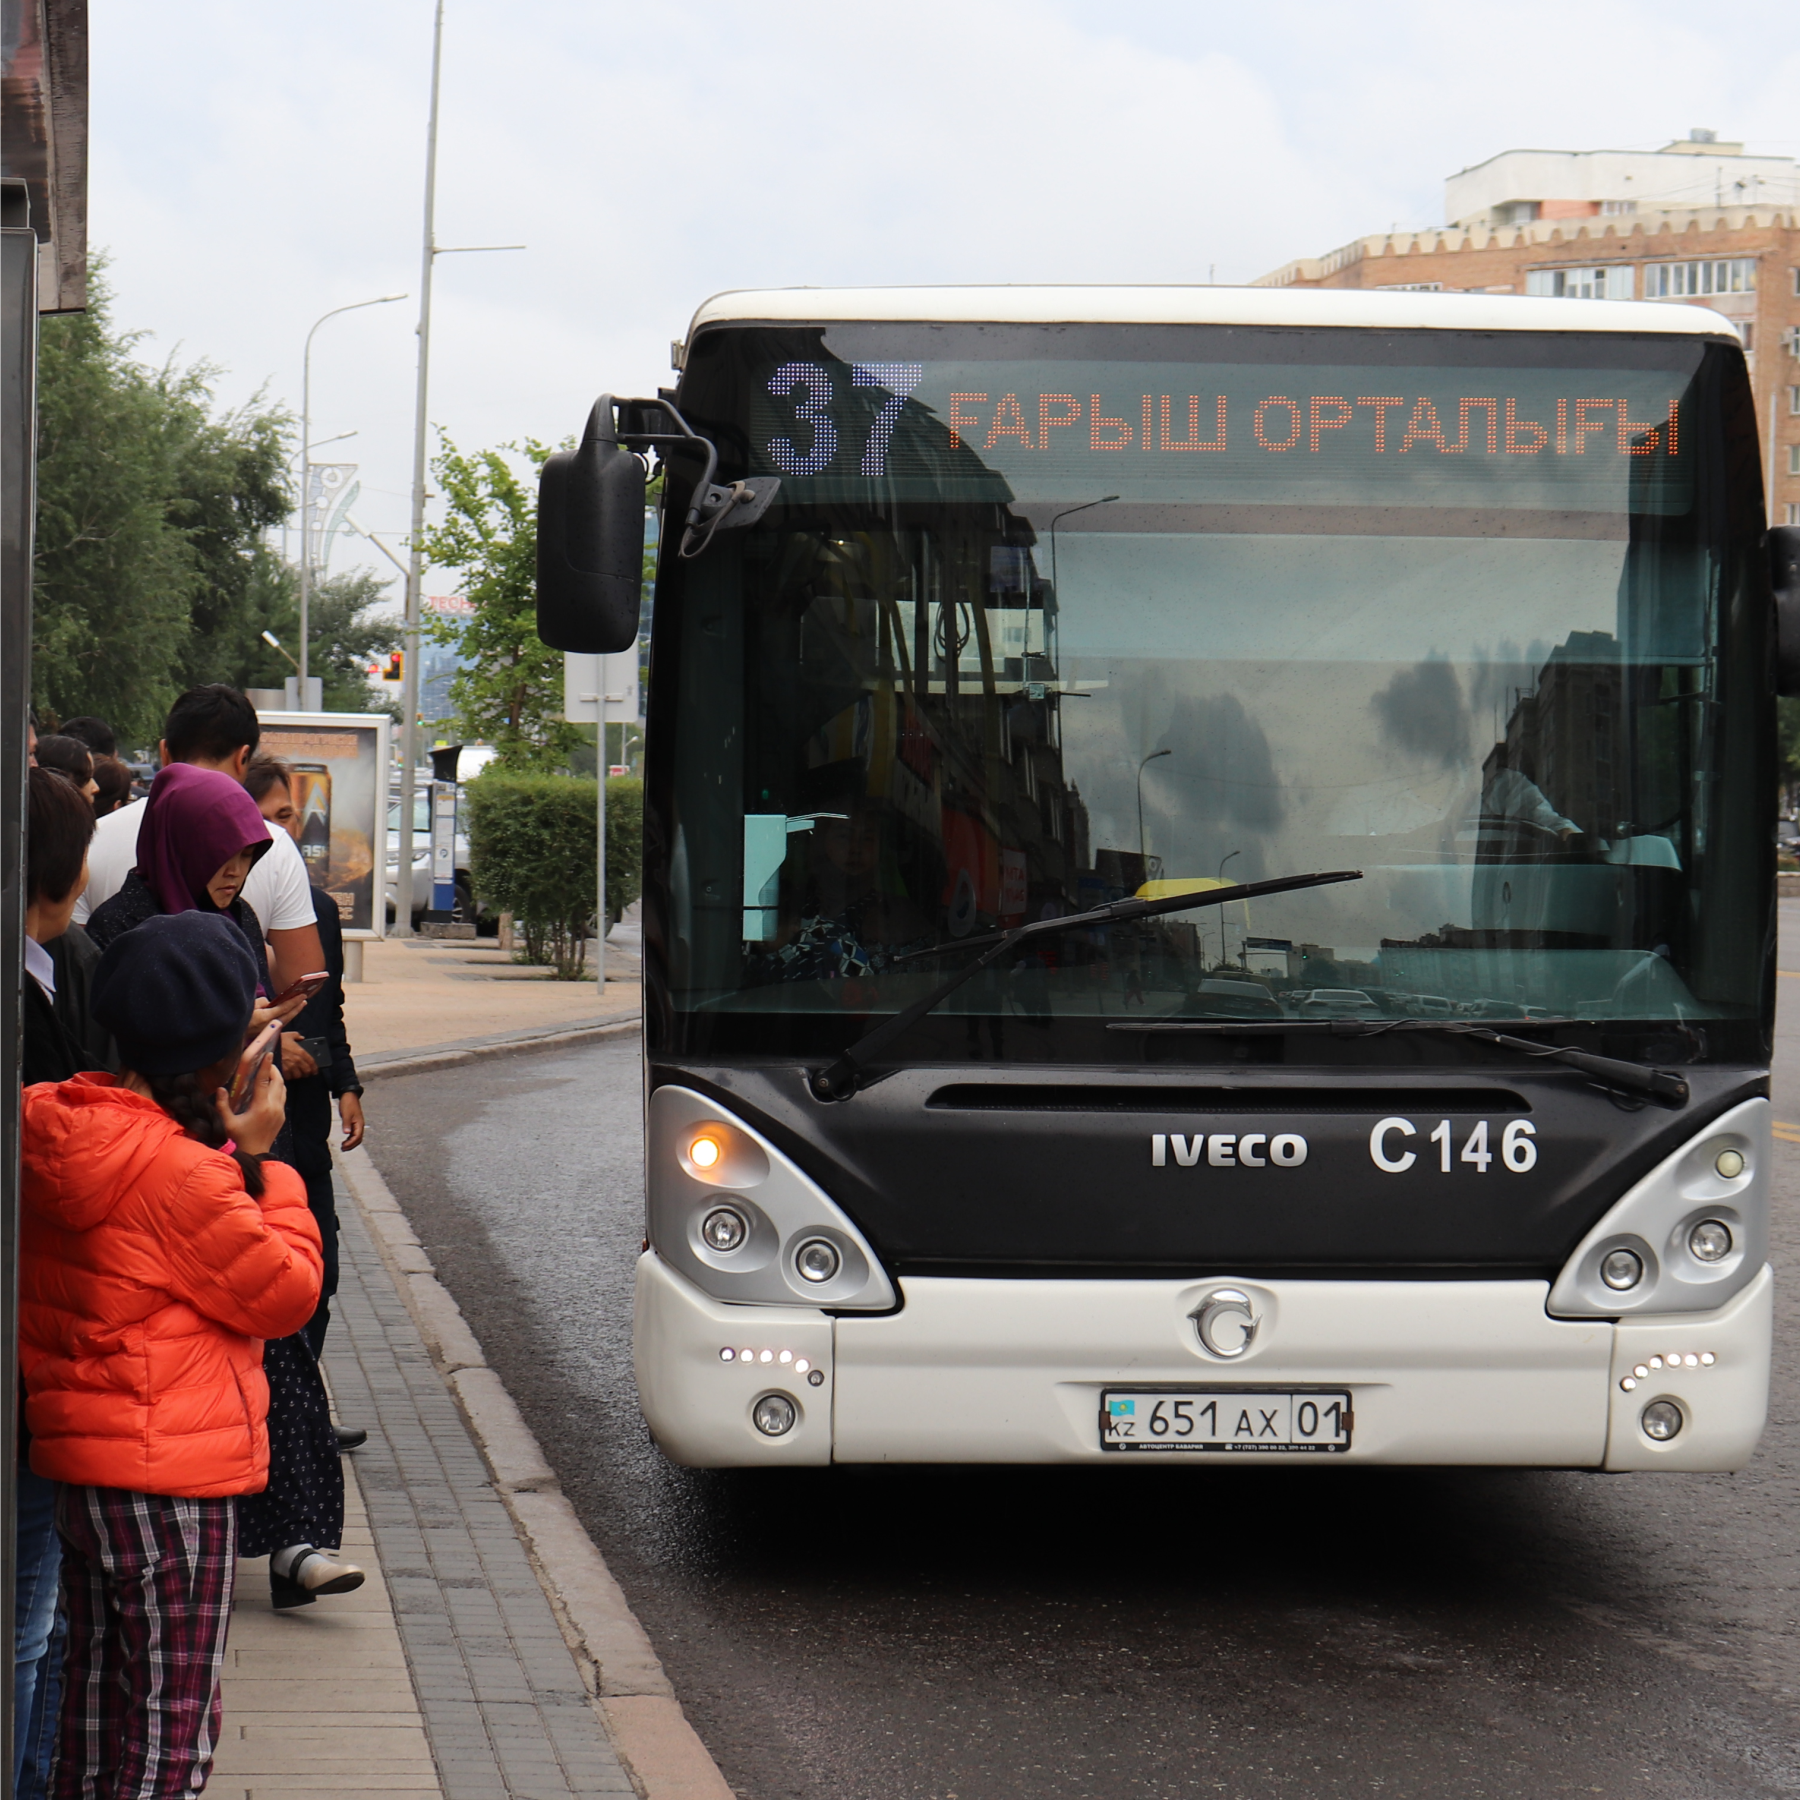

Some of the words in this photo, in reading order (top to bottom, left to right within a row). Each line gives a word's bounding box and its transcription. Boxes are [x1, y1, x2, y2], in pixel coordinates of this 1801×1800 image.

[766, 362, 923, 477] 37
[1151, 1133, 1308, 1167] IVECO
[1109, 1422, 1136, 1437] KZ
[1149, 1400, 1218, 1437] 651
[1297, 1401, 1342, 1438] 01
